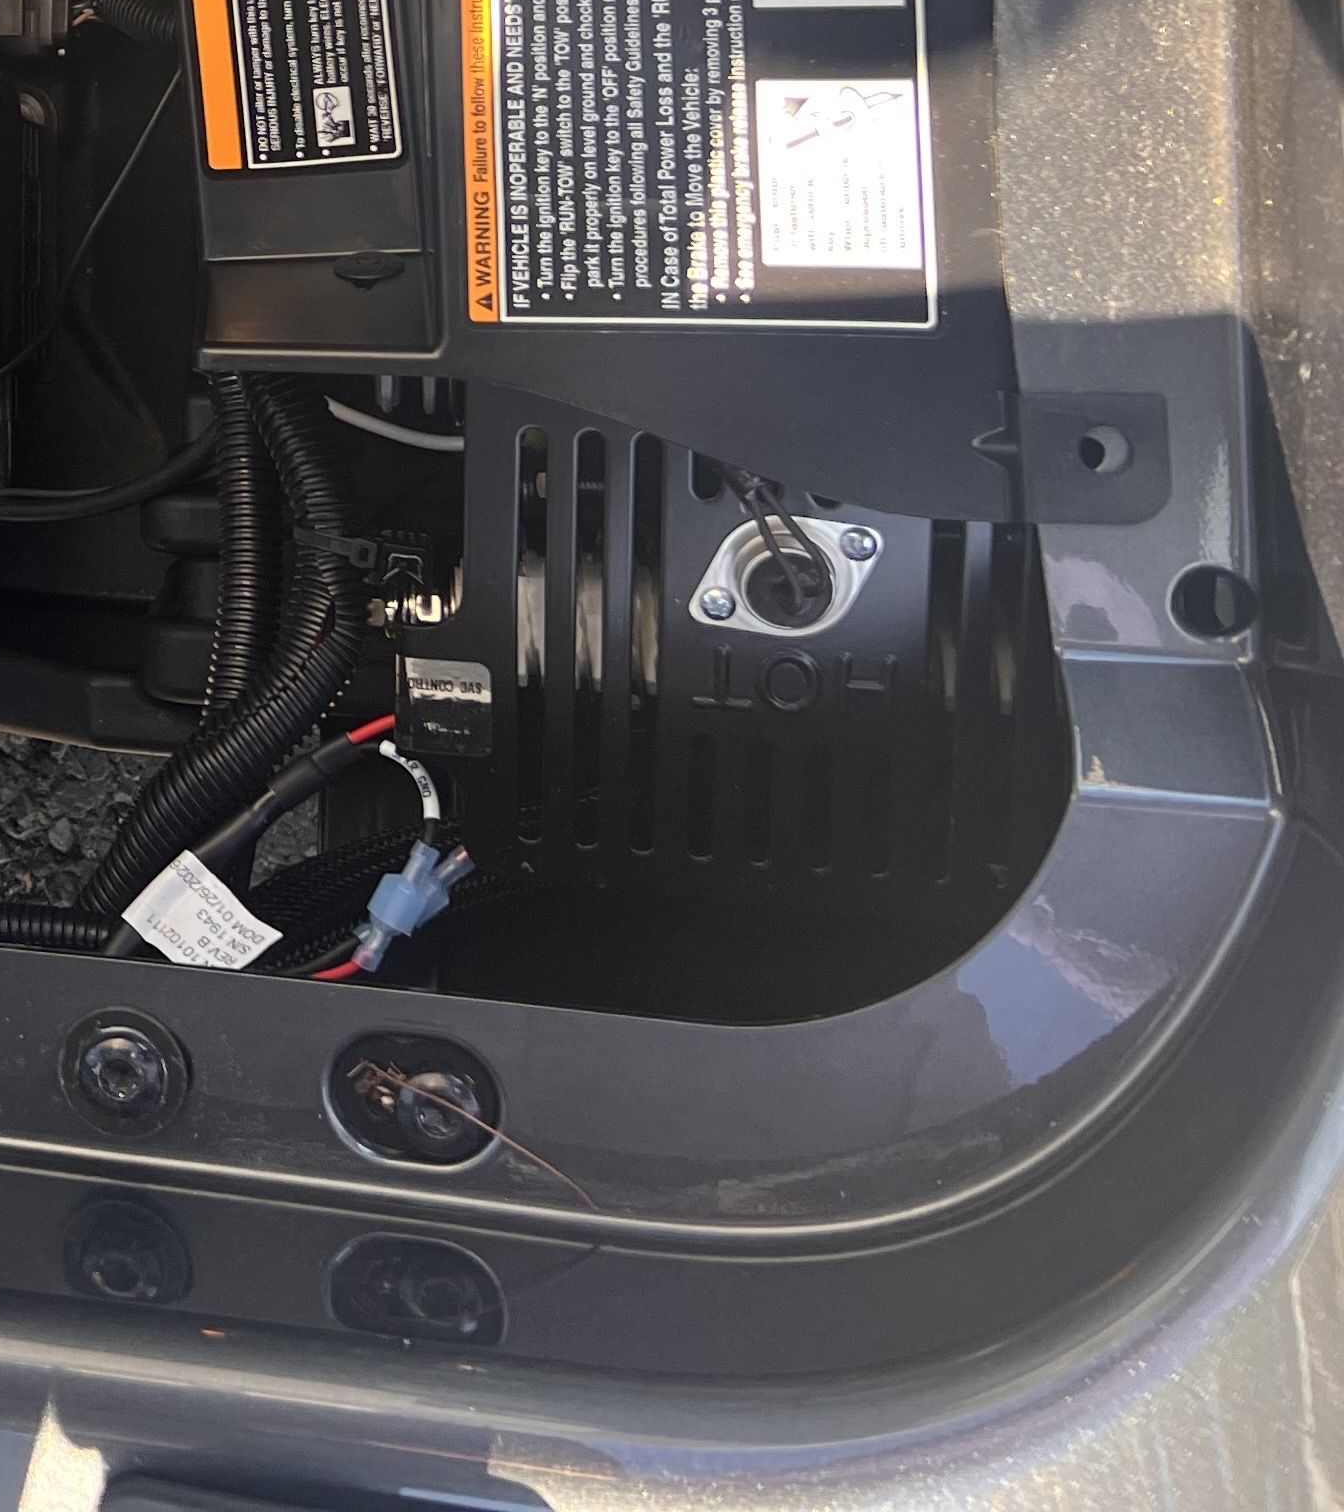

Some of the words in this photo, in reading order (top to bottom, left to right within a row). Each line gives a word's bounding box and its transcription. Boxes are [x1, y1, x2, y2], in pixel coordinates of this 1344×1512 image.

[504, 4, 523, 56] NEEDS
[652, 22, 671, 47] the
[468, 37, 484, 72] these
[530, 25, 551, 80] position
[653, 52, 672, 81] and
[506, 61, 524, 94] AND
[554, 69, 571, 91] the
[470, 77, 486, 116] follow
[556, 94, 571, 108] to
[625, 75, 646, 117] Safety
[654, 86, 674, 125] Loss
[679, 68, 701, 130] Vehicle:
[472, 120, 486, 133] to
[532, 105, 549, 127] the
[626, 122, 643, 138] all
[507, 99, 527, 200] INOPERABLE
[533, 130, 549, 144] to
[555, 112, 573, 156] switch
[682, 133, 702, 159] the
[471, 137, 488, 181] Failure
[533, 148, 553, 171] key
[655, 130, 675, 179] Power
[627, 142, 650, 204] following
[683, 163, 704, 205] Move
[510, 204, 528, 219] IS
[534, 176, 556, 227] ignition
[657, 185, 677, 223] Total
[659, 226, 678, 241] of
[686, 211, 705, 226] to
[473, 191, 492, 285] WARNING
[536, 231, 553, 253] the
[559, 238, 576, 260] the
[630, 209, 652, 287] procedures
[510, 223, 530, 290] VEHICLE
[659, 246, 680, 286] Case
[685, 232, 708, 279] Brake
[536, 257, 553, 287] Turn
[560, 263, 580, 289] Flip
[512, 293, 529, 307] IF
[660, 292, 680, 308] IN
[687, 282, 709, 308] the
[692, 644, 898, 712] HOT
[196, 909, 227, 939] 1943
[197, 935, 210, 948] B
